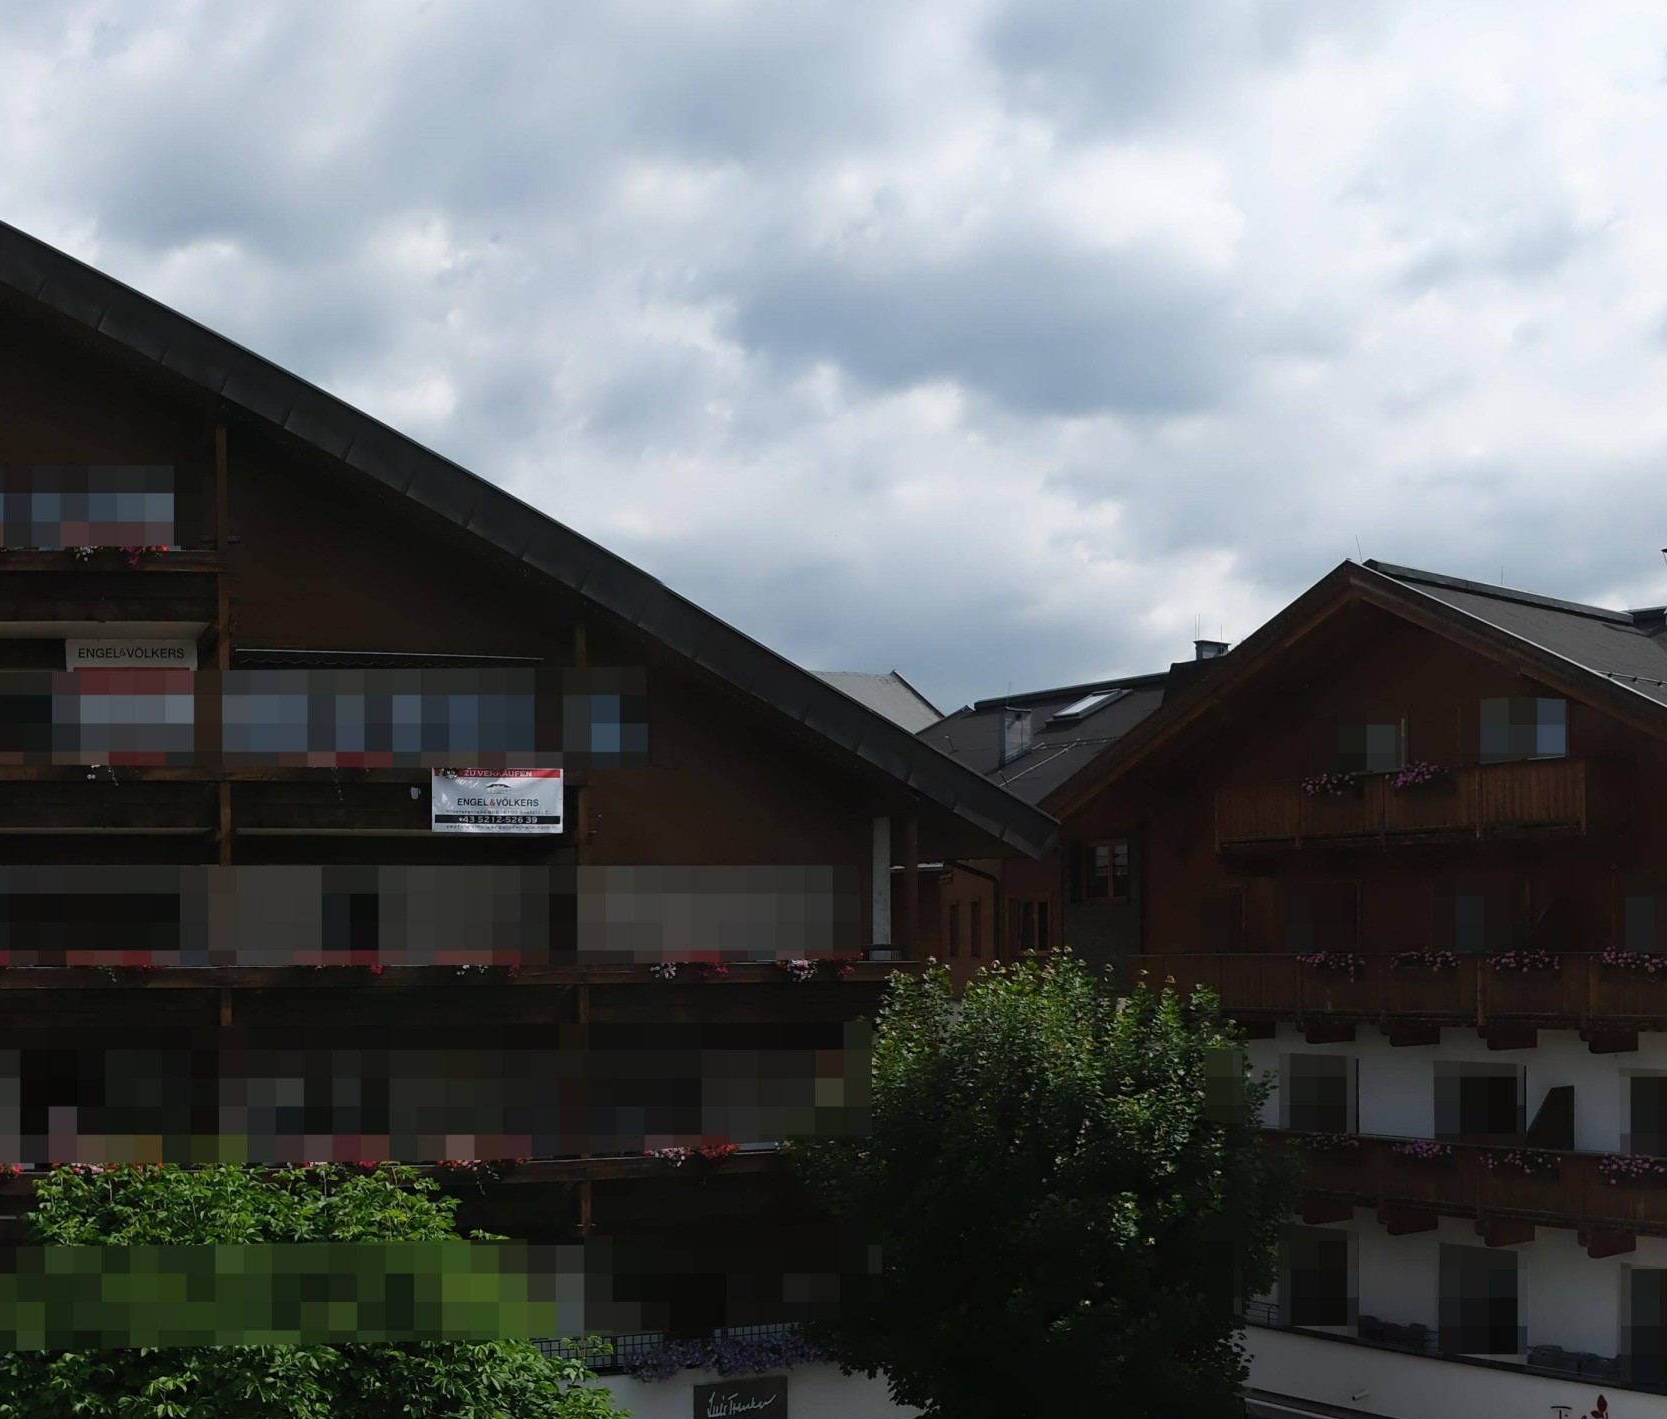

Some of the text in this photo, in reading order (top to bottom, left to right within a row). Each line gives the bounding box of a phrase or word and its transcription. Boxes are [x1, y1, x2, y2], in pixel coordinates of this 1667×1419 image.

[78, 645, 185, 659] ENGEL&VÖLKERS
[457, 797, 539, 807] ENGEL&VÖLKERS
[478, 816, 523, 824] 5212-526
